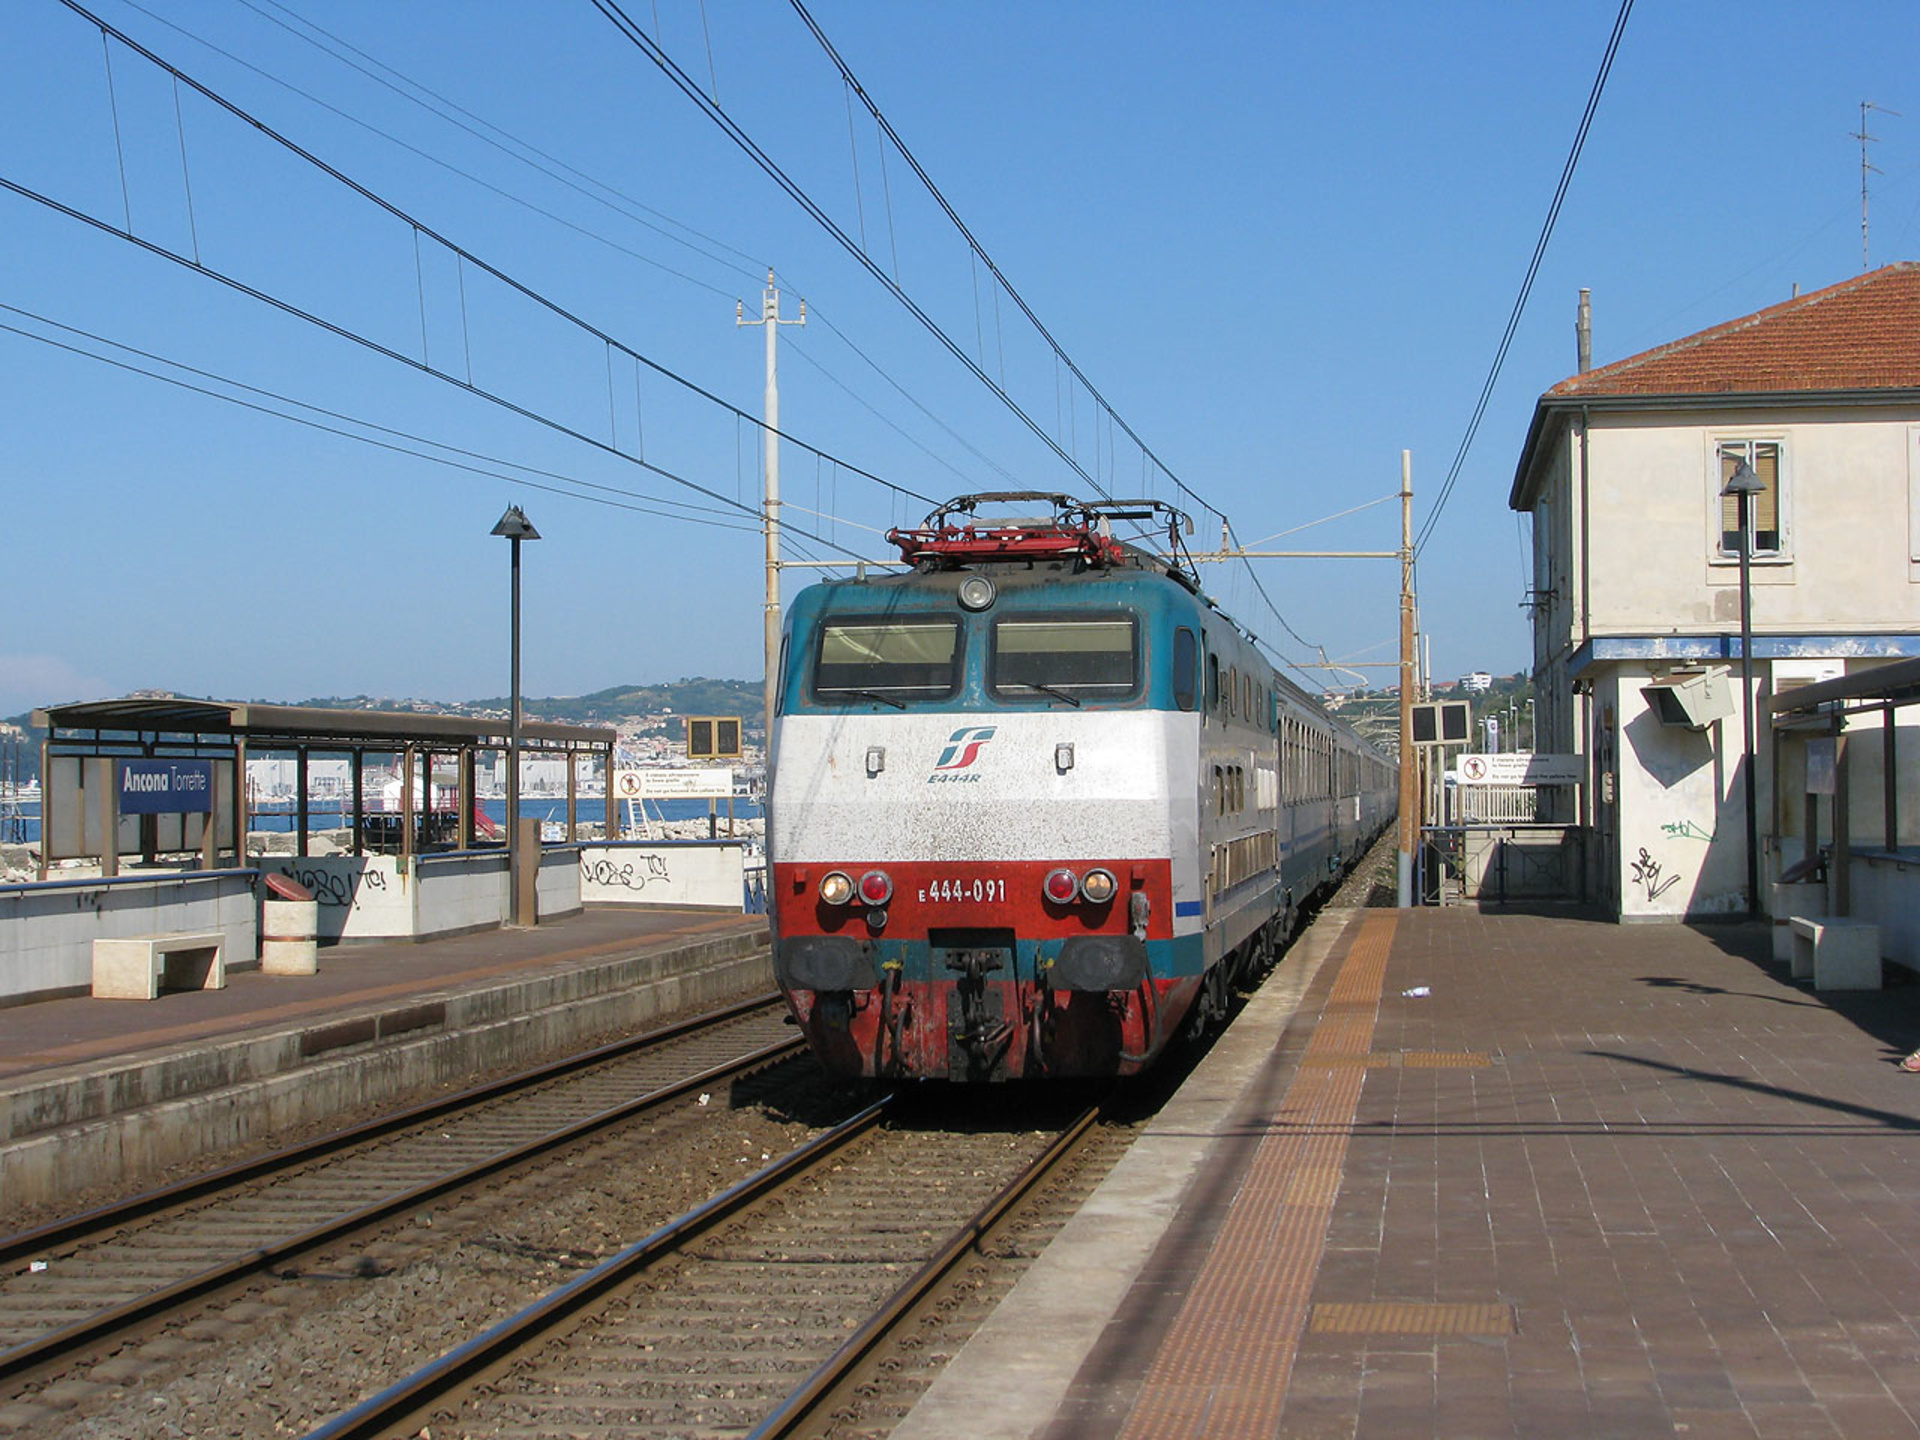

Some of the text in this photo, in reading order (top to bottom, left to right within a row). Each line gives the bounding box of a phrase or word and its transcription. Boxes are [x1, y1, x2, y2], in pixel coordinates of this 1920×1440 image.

[123, 766, 206, 792] Ancona Torrette
[927, 774, 981, 784] E444R
